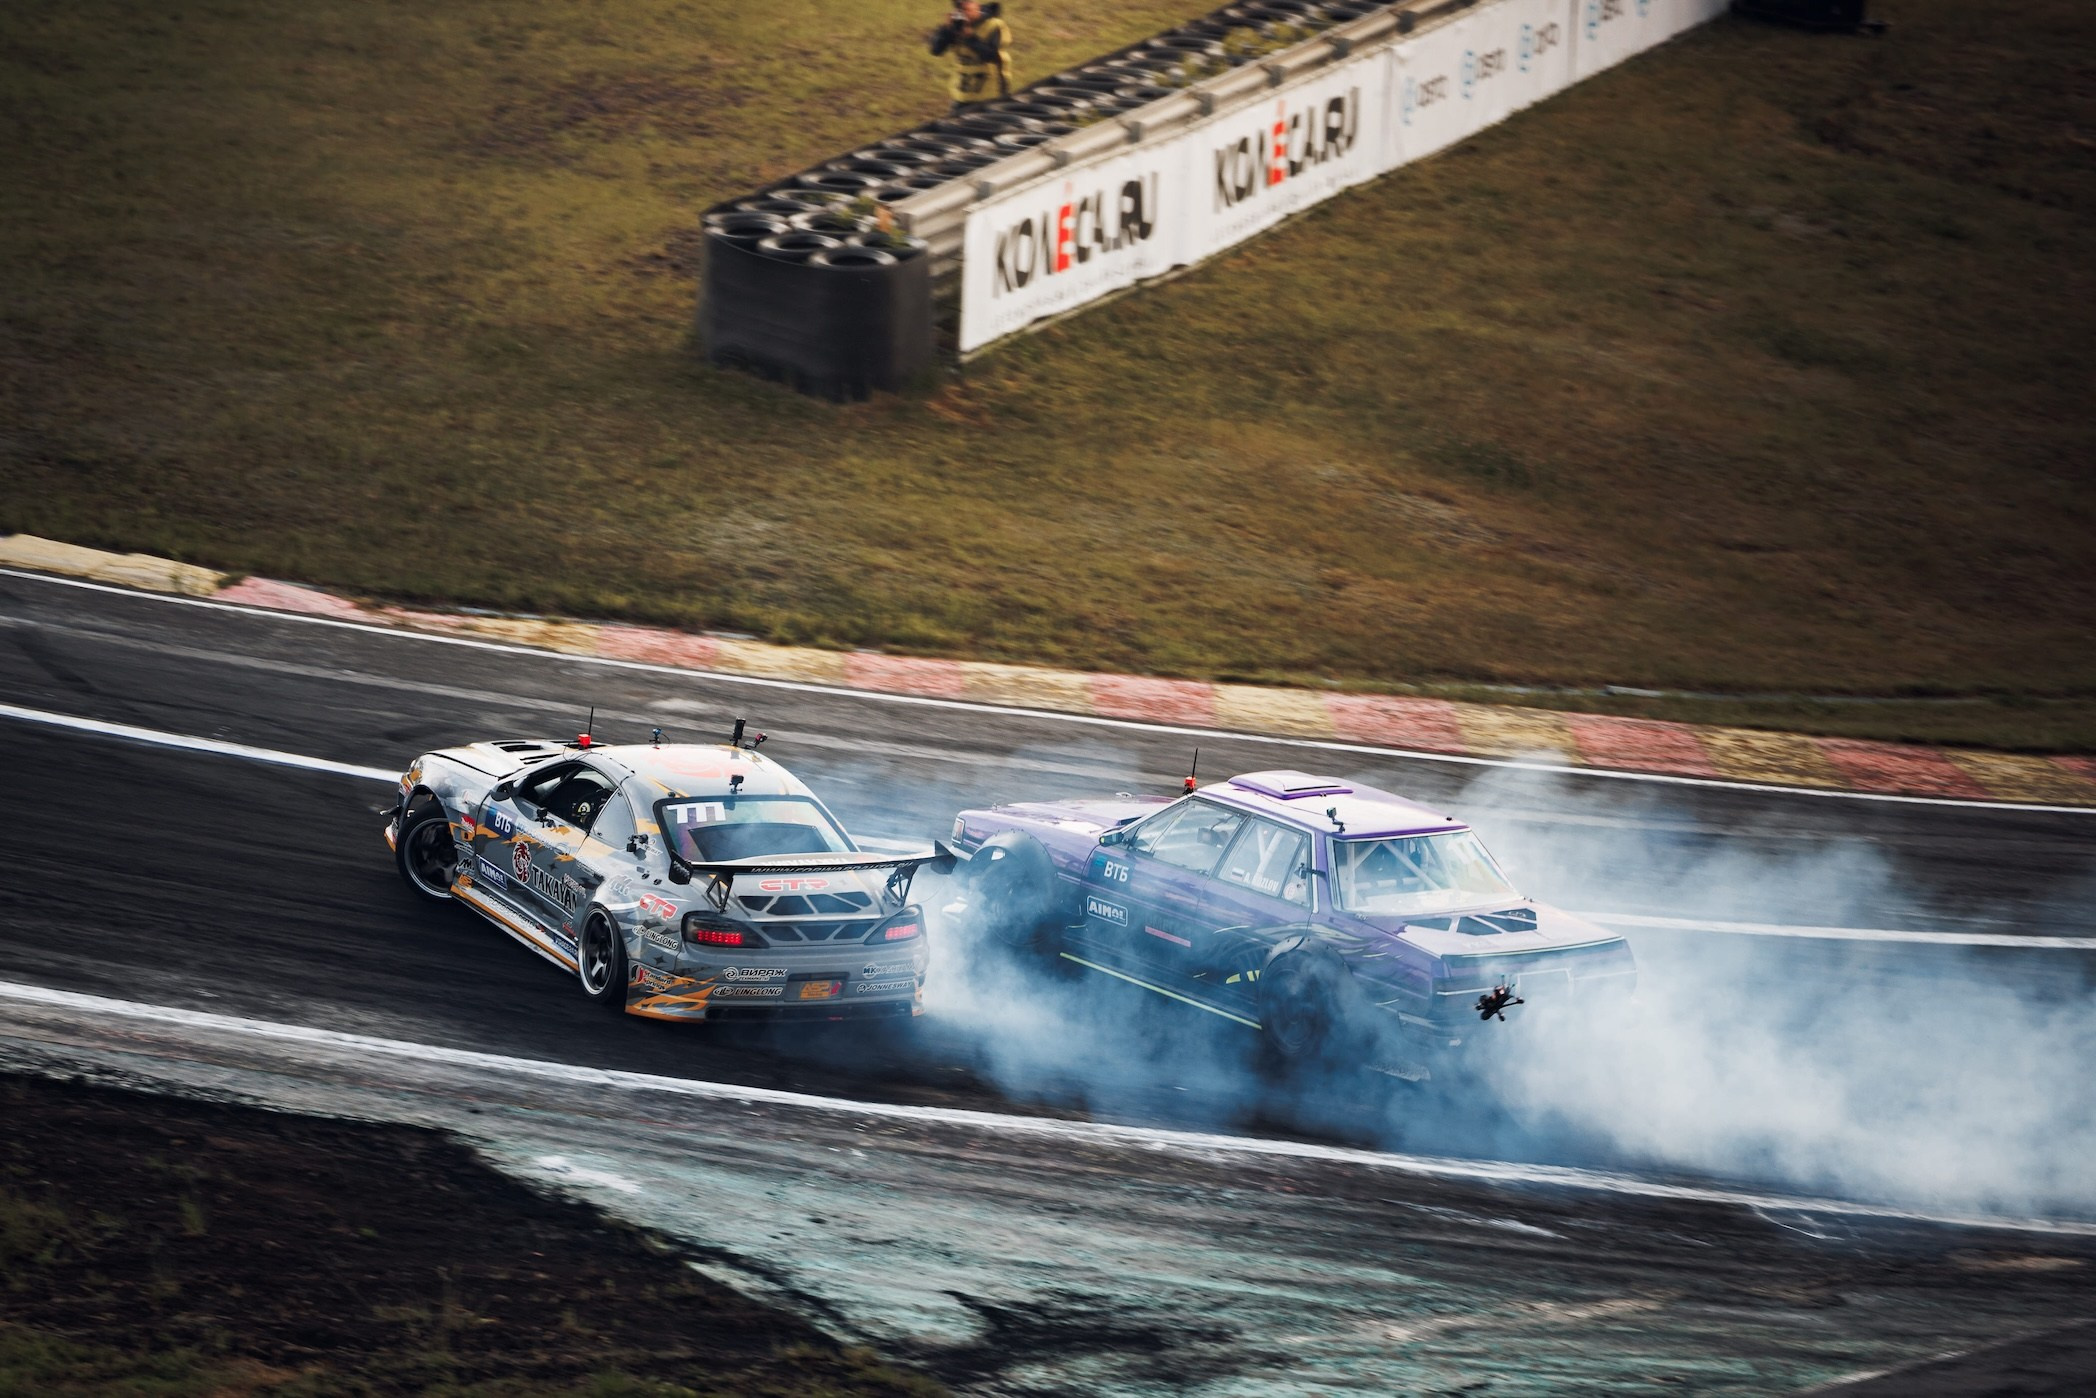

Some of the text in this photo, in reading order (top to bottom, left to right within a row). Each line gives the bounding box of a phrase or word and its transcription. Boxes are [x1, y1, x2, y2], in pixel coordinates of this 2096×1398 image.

[494, 811, 513, 834] ВТБ
[1103, 860, 1129, 883] ВТБ
[759, 877, 830, 892] CTR
[639, 892, 678, 921] CTR
[644, 928, 679, 951] LINGLONG
[740, 967, 788, 978] ВИРАЖ
[734, 986, 784, 996] LINGLONG
[866, 980, 912, 992] JONNESWAY
